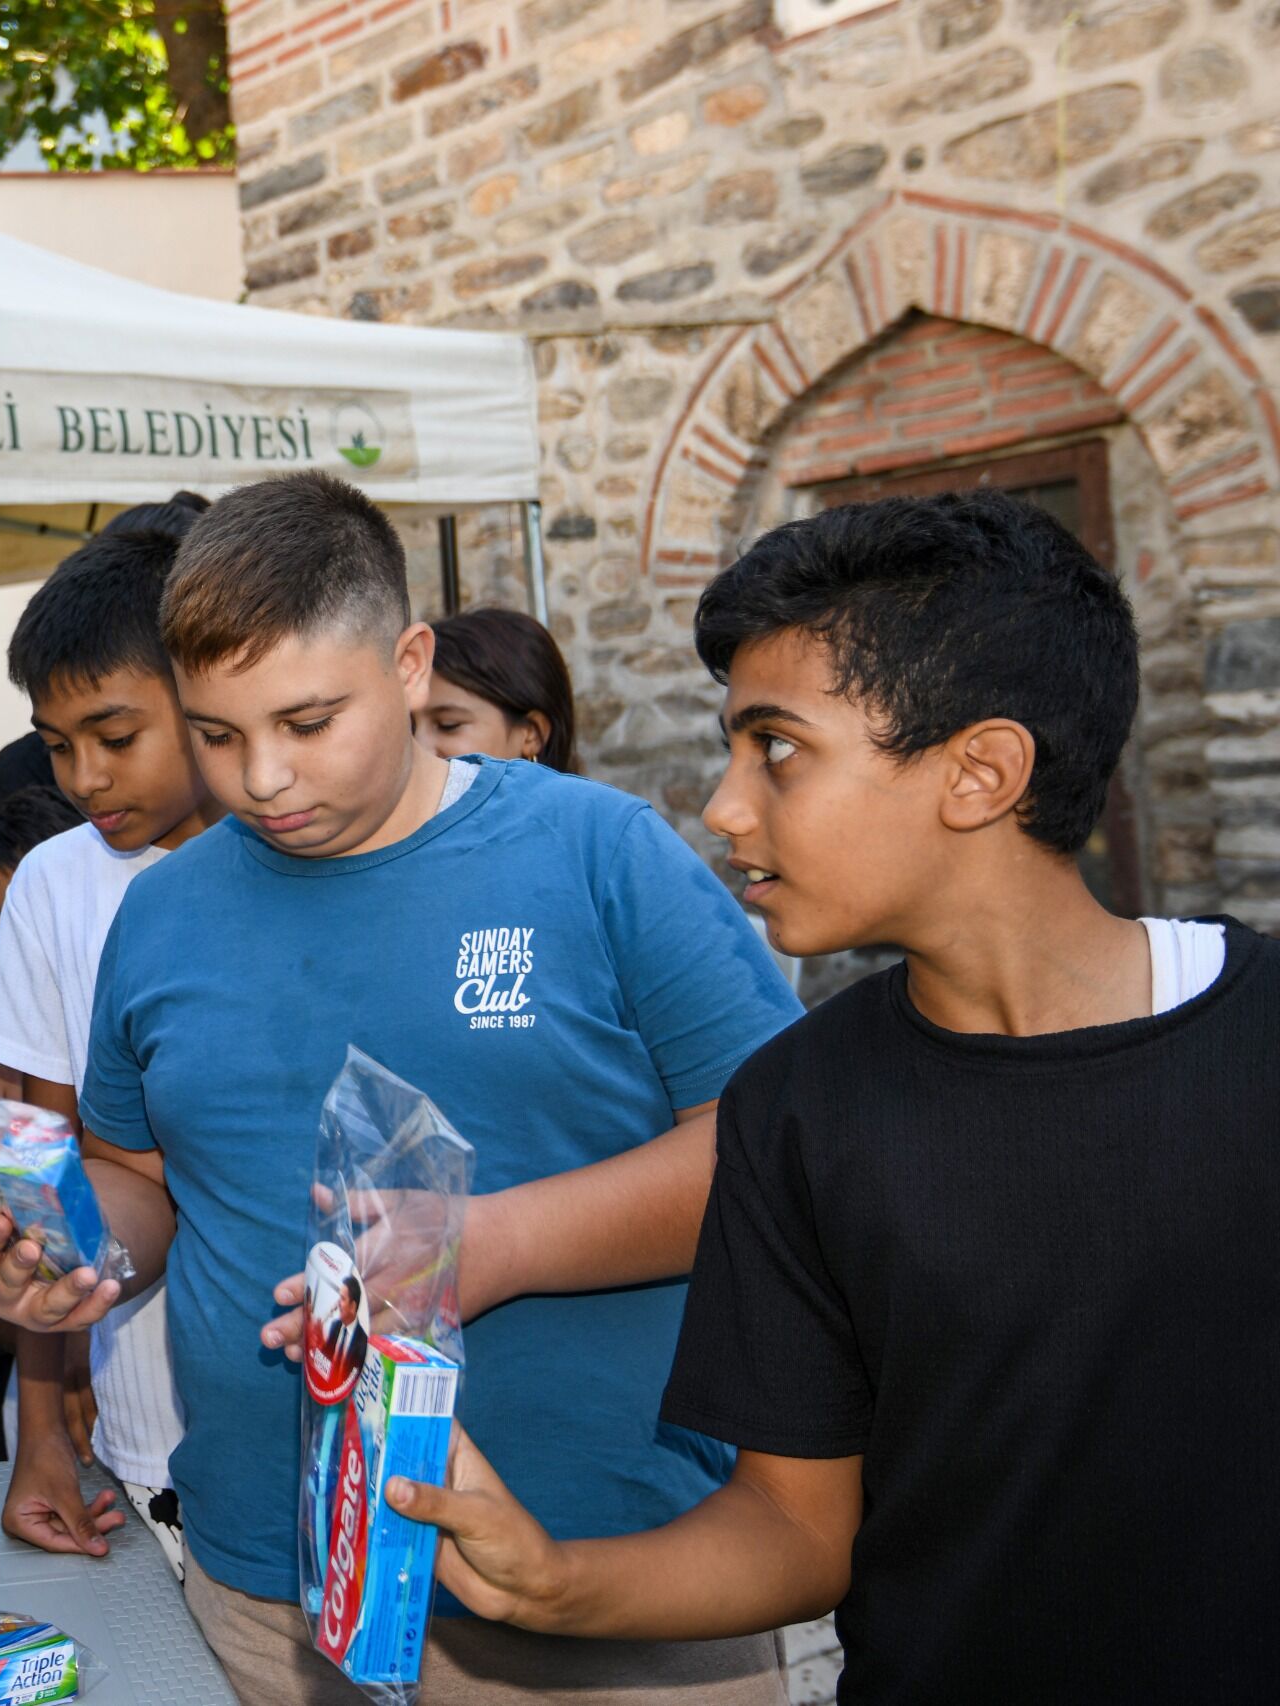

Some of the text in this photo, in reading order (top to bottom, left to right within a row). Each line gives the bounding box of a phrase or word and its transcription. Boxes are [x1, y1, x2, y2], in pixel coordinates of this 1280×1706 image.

[56, 403, 314, 460] BELEDİYESİ
[458, 927, 535, 956] SUNDAY
[455, 950, 534, 979] GAMERS
[453, 973, 531, 1014] Club
[469, 1014, 536, 1030] SINCE 1987
[324, 1448, 363, 1649] Colgate
[21, 1651, 65, 1674] Triple
[10, 1669, 63, 1692] Action
